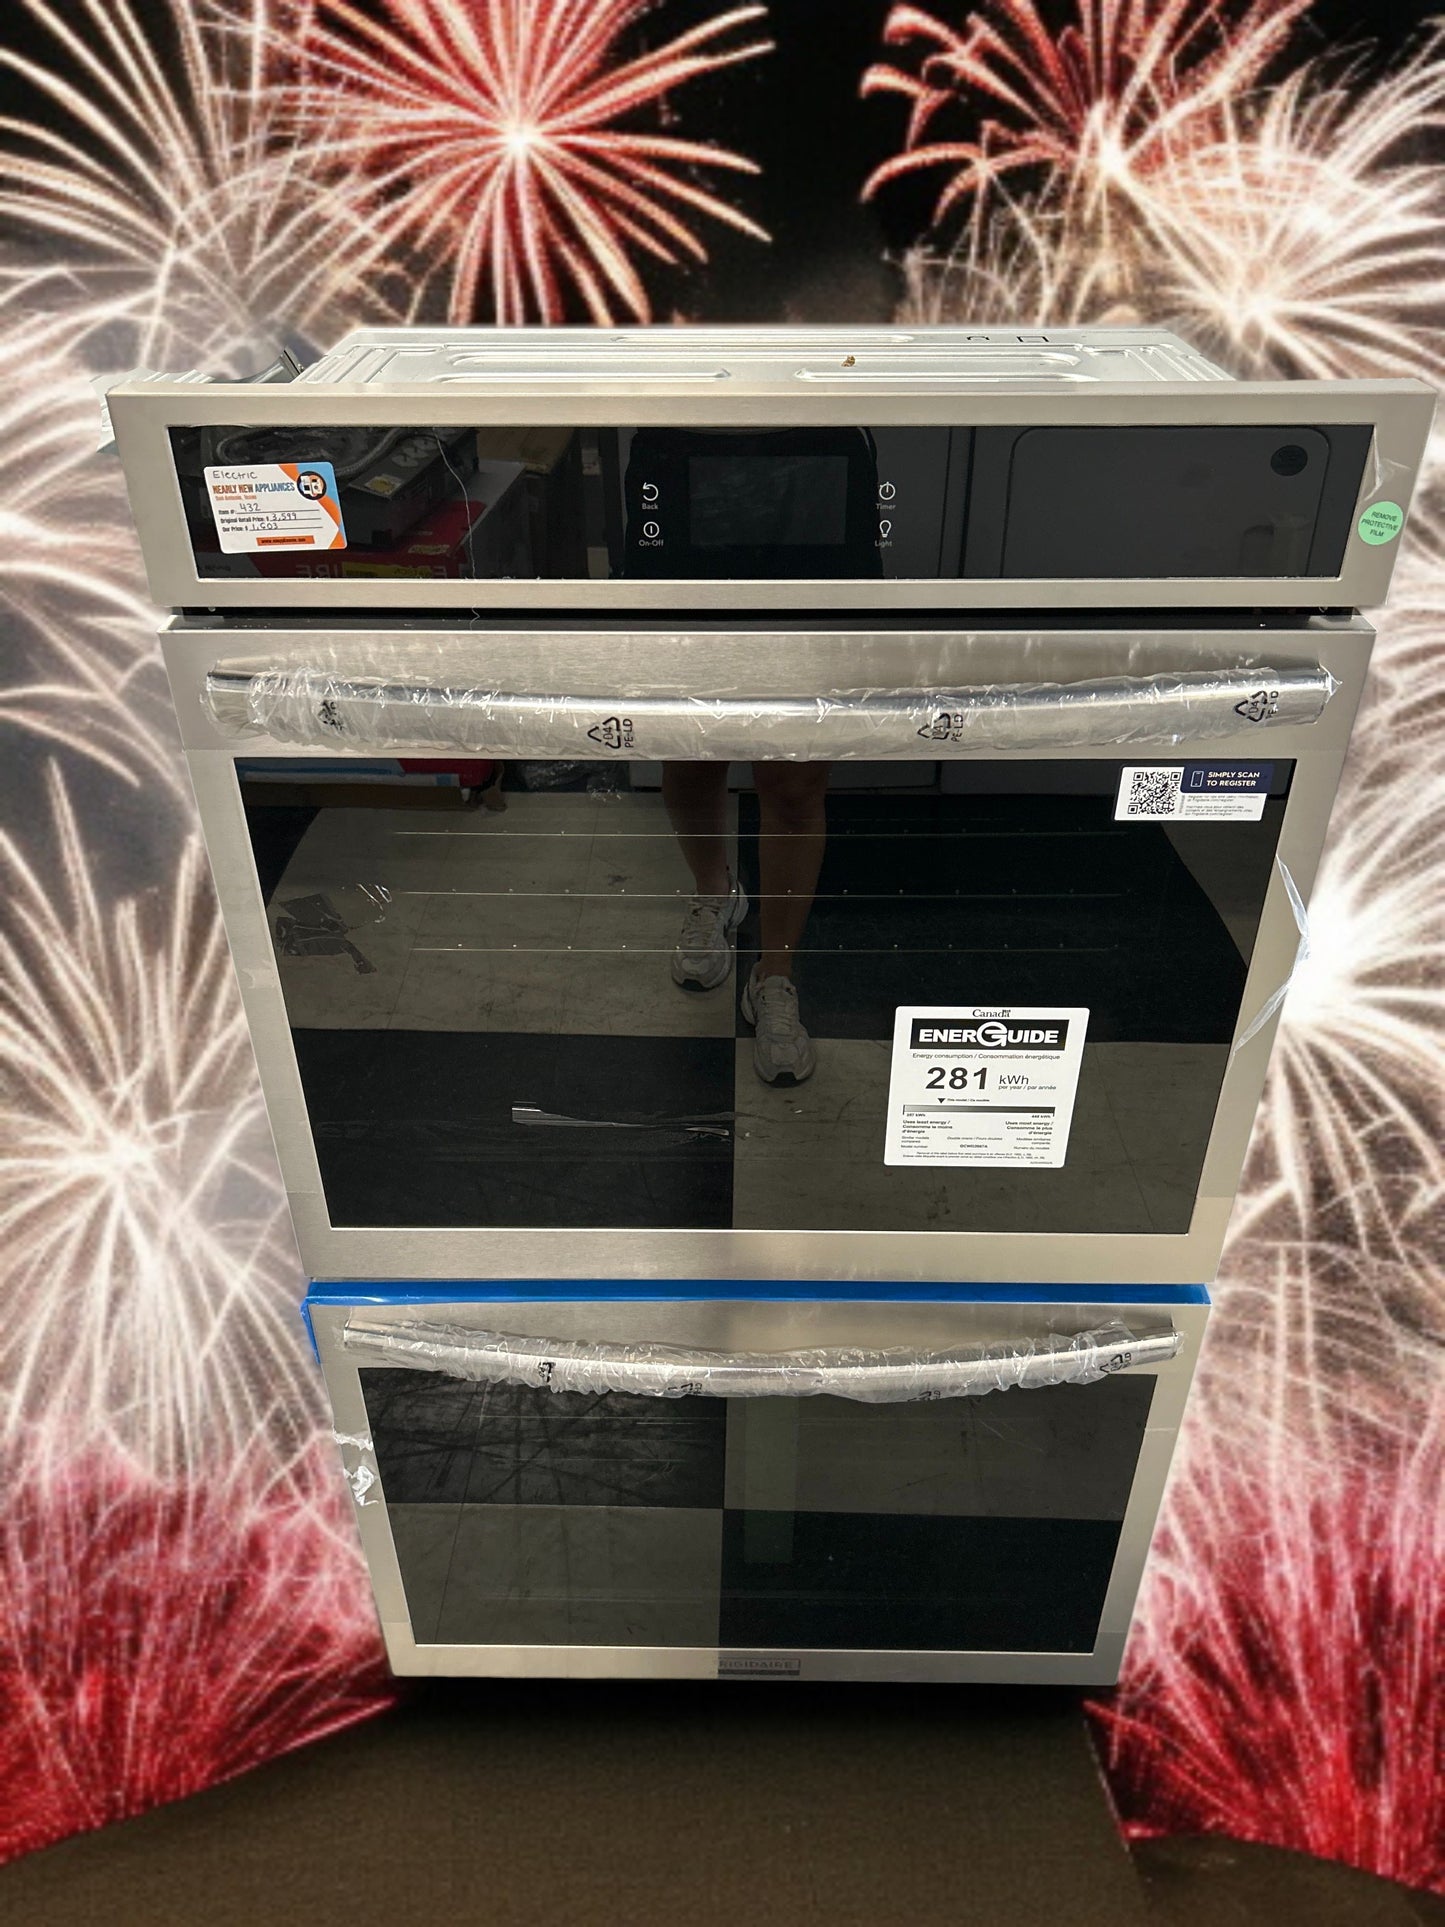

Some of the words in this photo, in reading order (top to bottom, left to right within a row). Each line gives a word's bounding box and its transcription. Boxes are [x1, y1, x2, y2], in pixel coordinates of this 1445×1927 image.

[213, 470, 257, 480] Electric
[212, 483, 237, 494] NEARLY
[239, 483, 254, 494] NEW
[254, 481, 296, 493] APPLIANCES
[240, 503, 261, 512] 432
[1371, 511, 1397, 522] REMOVE
[1361, 518, 1399, 532] PROTECTIVE
[1369, 529, 1385, 537] FILM
[638, 539, 664, 547] On-Off
[622, 718, 635, 748] PE-LD
[972, 1009, 1011, 1018] Canada
[919, 1021, 1059, 1047] ENERGUIDE
[925, 1067, 988, 1090] 281
[999, 1075, 1030, 1085] kWh
